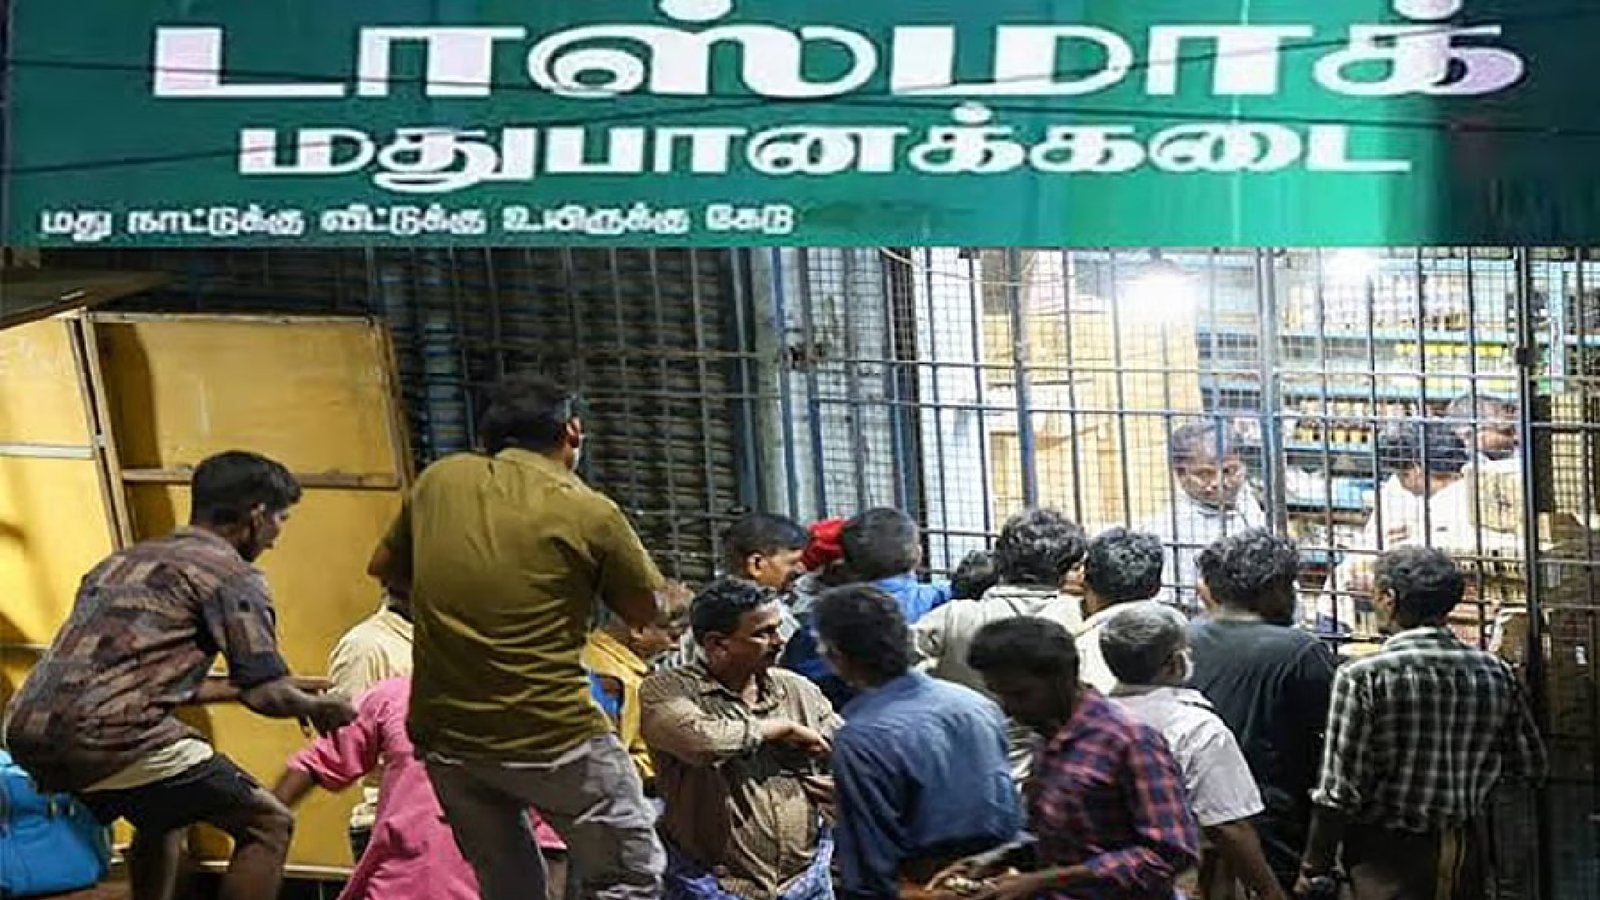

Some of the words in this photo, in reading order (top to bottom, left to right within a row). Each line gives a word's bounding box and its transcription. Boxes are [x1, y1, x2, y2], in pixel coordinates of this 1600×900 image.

[154, 0, 1524, 98] டாஸ்மாக்
[239, 103, 1410, 193] மதுபானக்கடை
[40, 209, 112, 241] மது
[127, 205, 305, 236] நாட்டுக்கு
